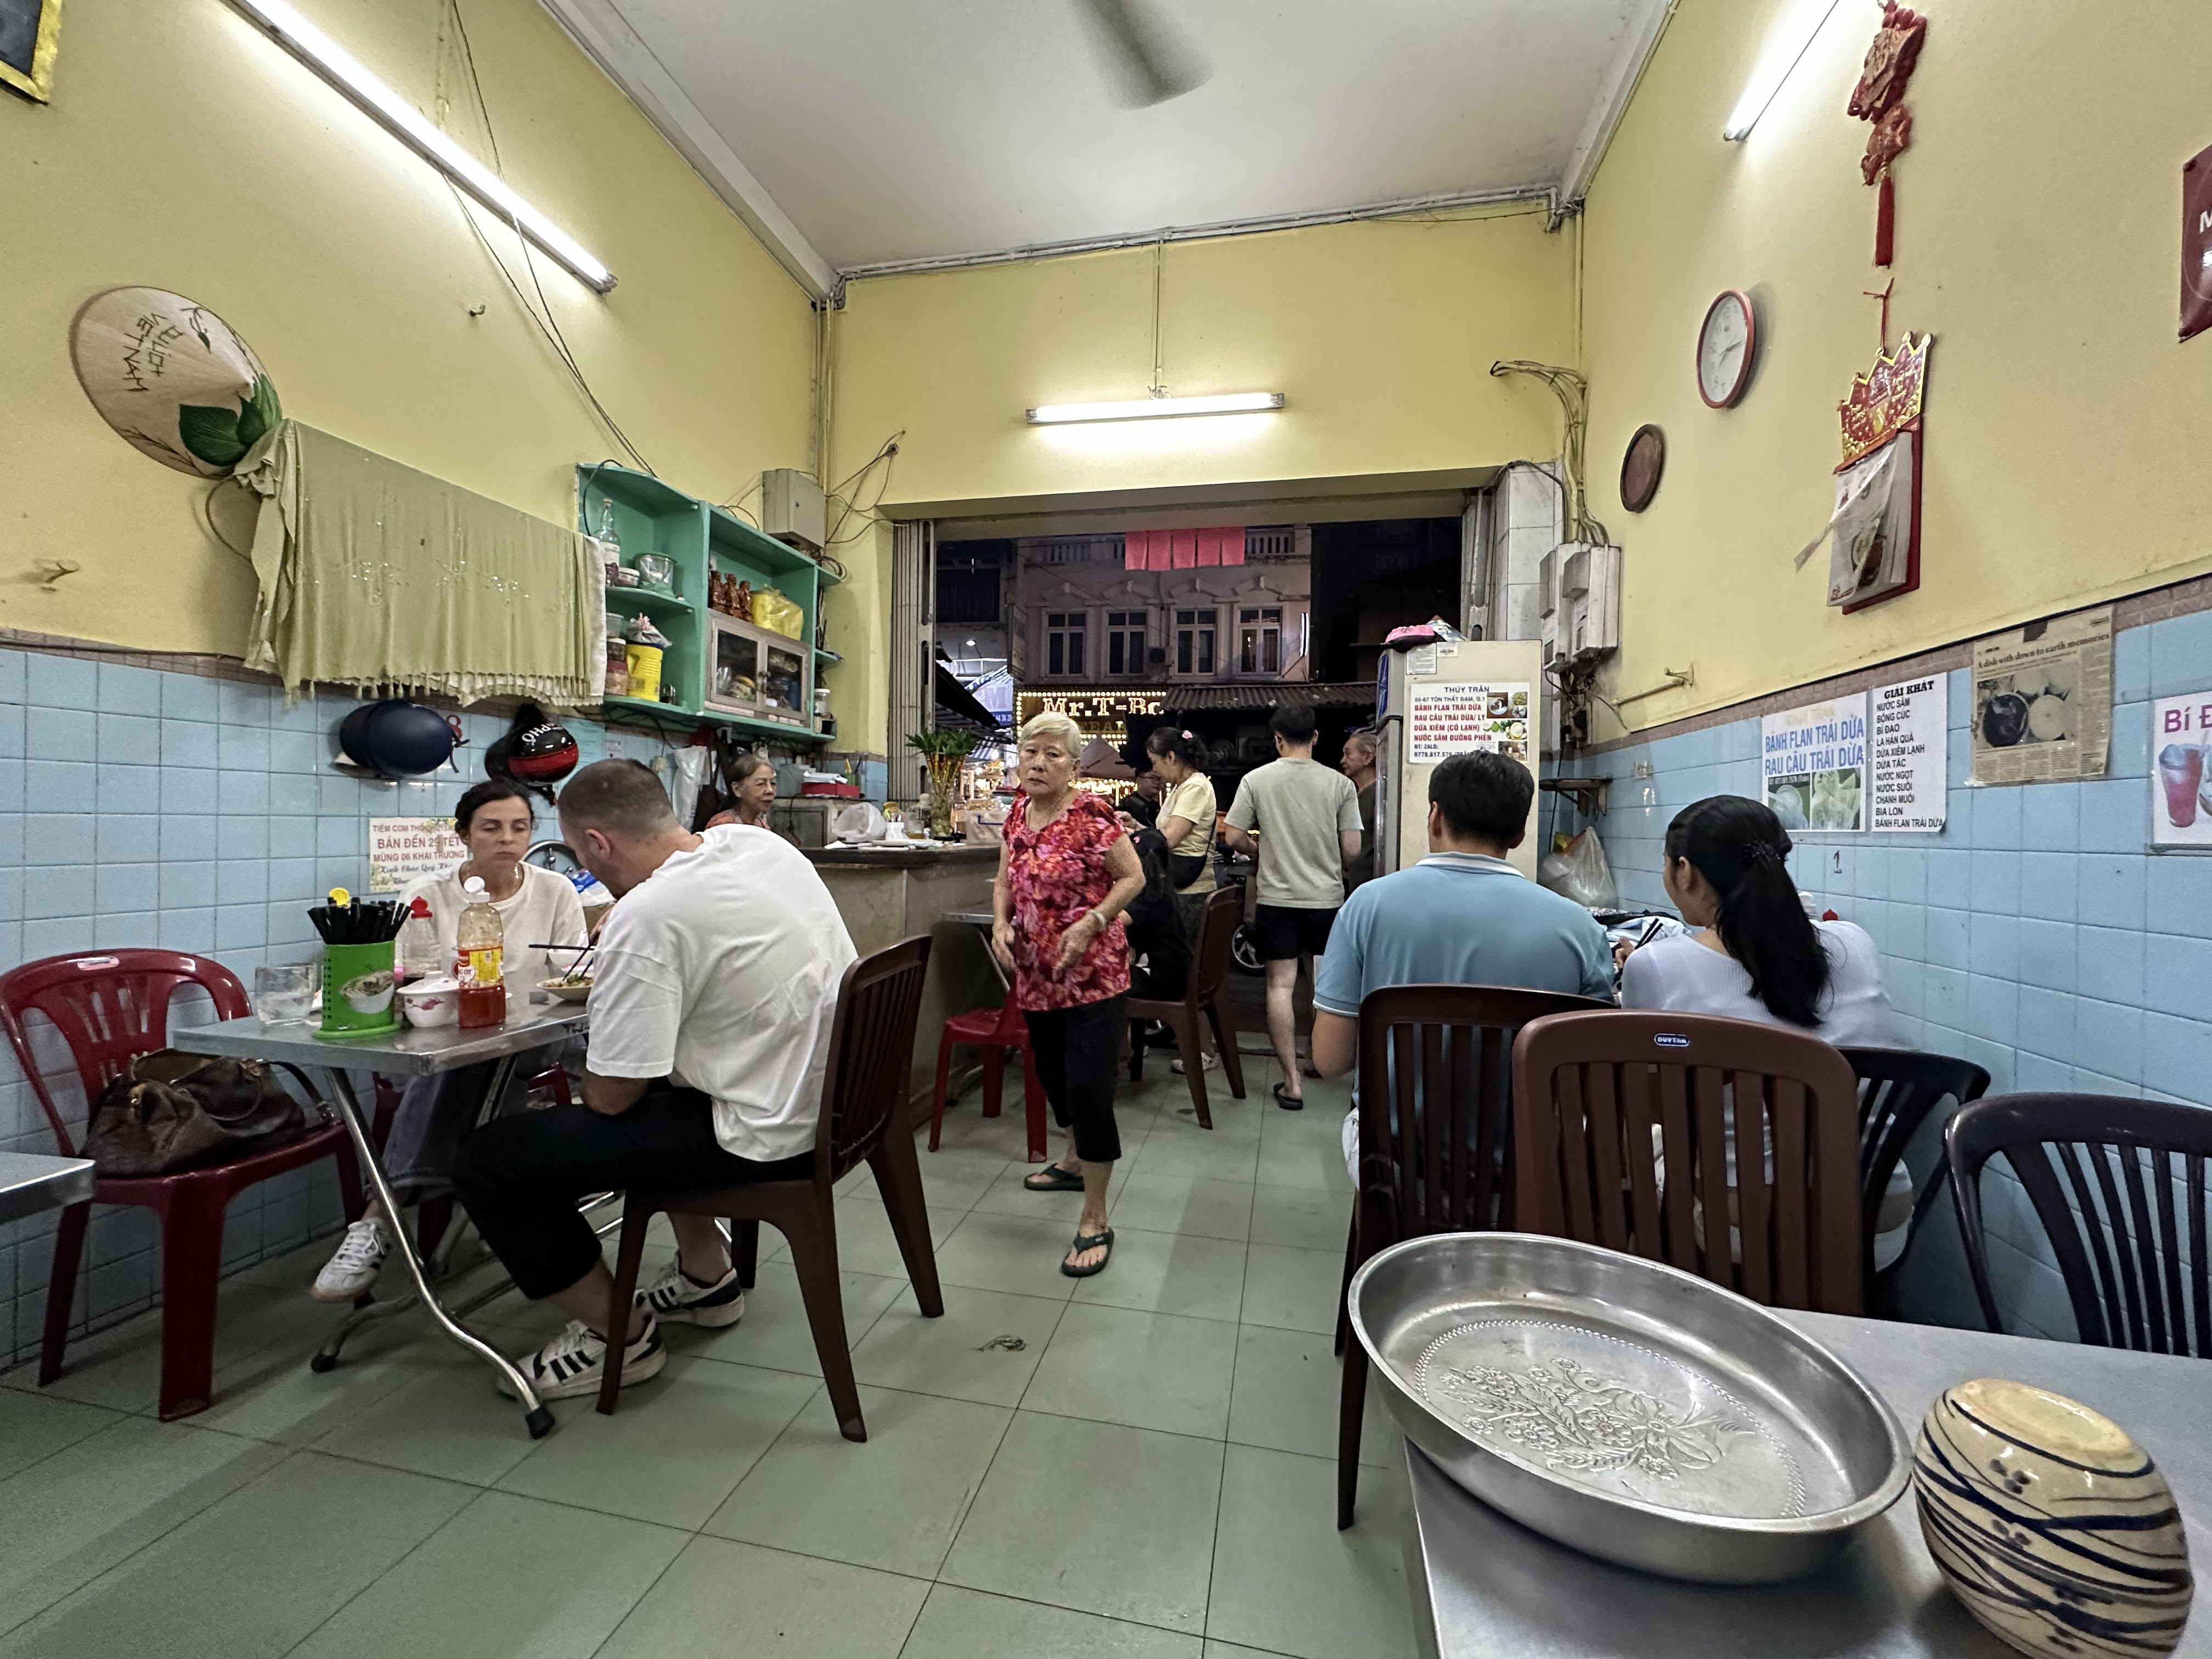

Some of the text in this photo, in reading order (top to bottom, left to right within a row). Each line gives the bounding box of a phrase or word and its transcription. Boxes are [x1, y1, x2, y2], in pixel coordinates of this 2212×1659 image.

[2164, 706, 2191, 733] Bí
[1790, 727, 1813, 749] FLAN
[1815, 719, 1837, 744] TRÁI
[1841, 715, 1864, 741] DỪA
[1765, 742, 1865, 776] RAU CÂU TRÁI DỪA
[1875, 807, 1903, 816] BIA LON
[1893, 819, 1910, 827] FLAN
[413, 852, 432, 861] KHAI
